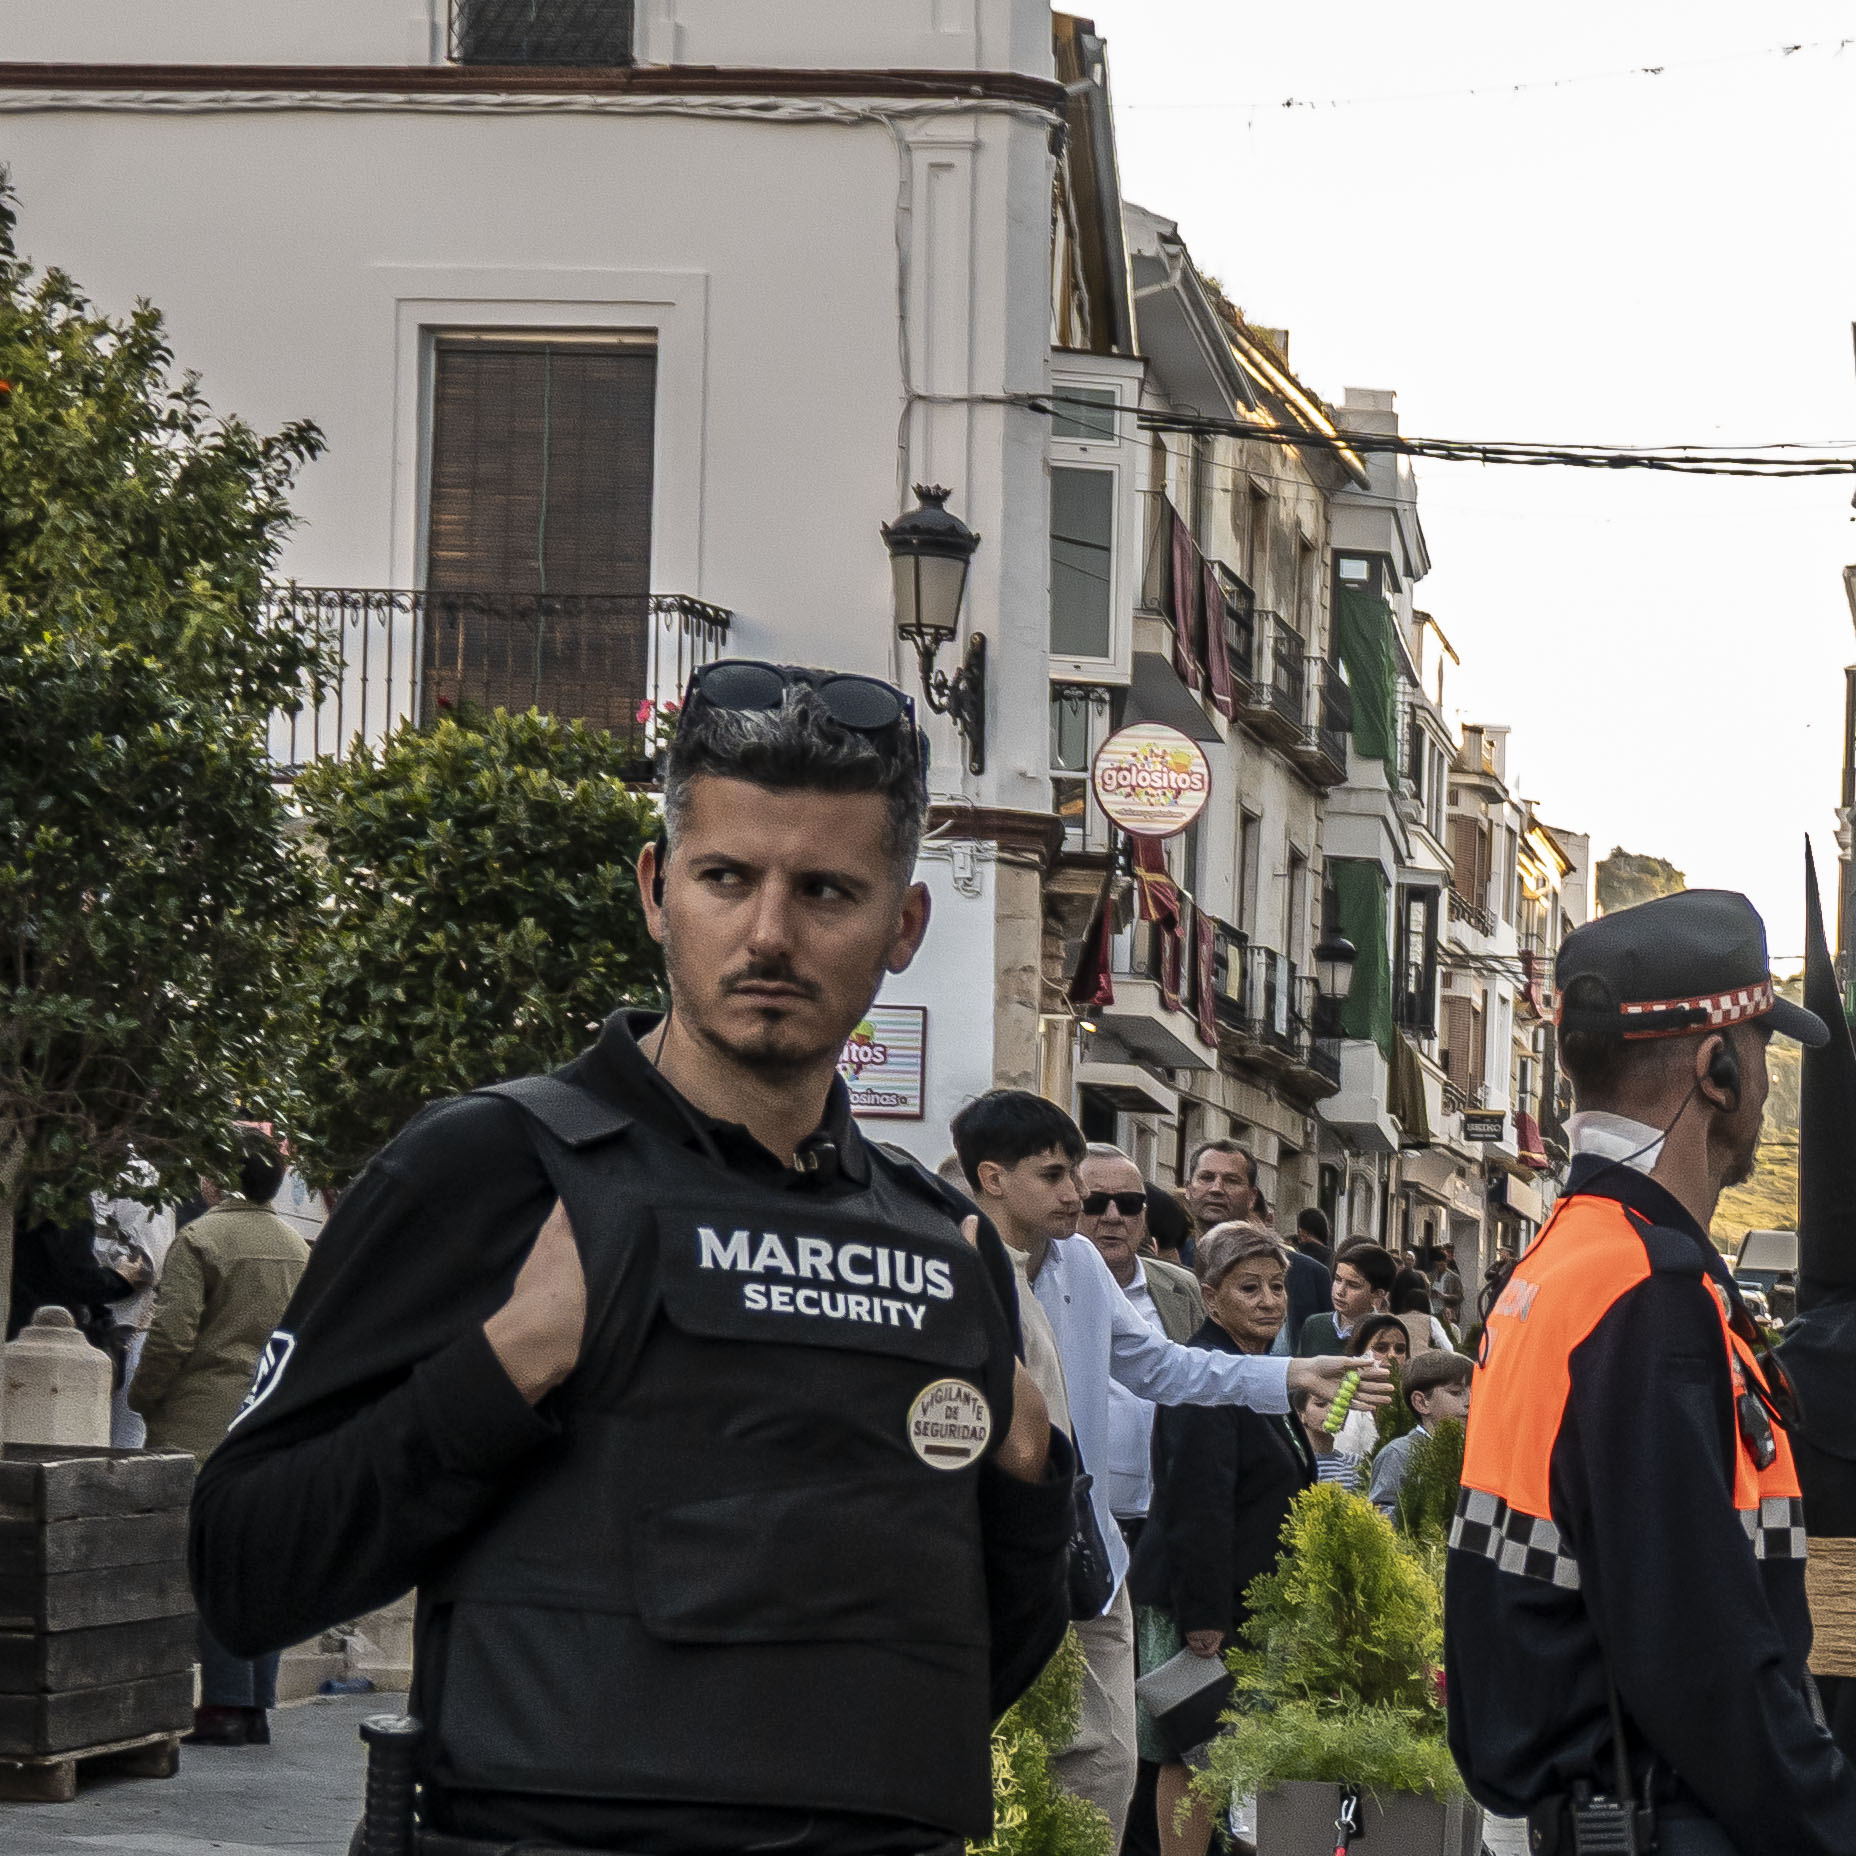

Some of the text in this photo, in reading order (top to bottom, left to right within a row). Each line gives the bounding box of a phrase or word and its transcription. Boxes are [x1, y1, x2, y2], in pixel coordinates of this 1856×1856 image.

[1102, 764, 1204, 792] golositos
[697, 1228, 954, 1300] MARCIUS
[743, 1284, 926, 1330] SECURITY
[921, 1386, 984, 1420] VIGILANTE
[945, 1405, 959, 1420] DE
[914, 1421, 986, 1441] SEGURIDAD
